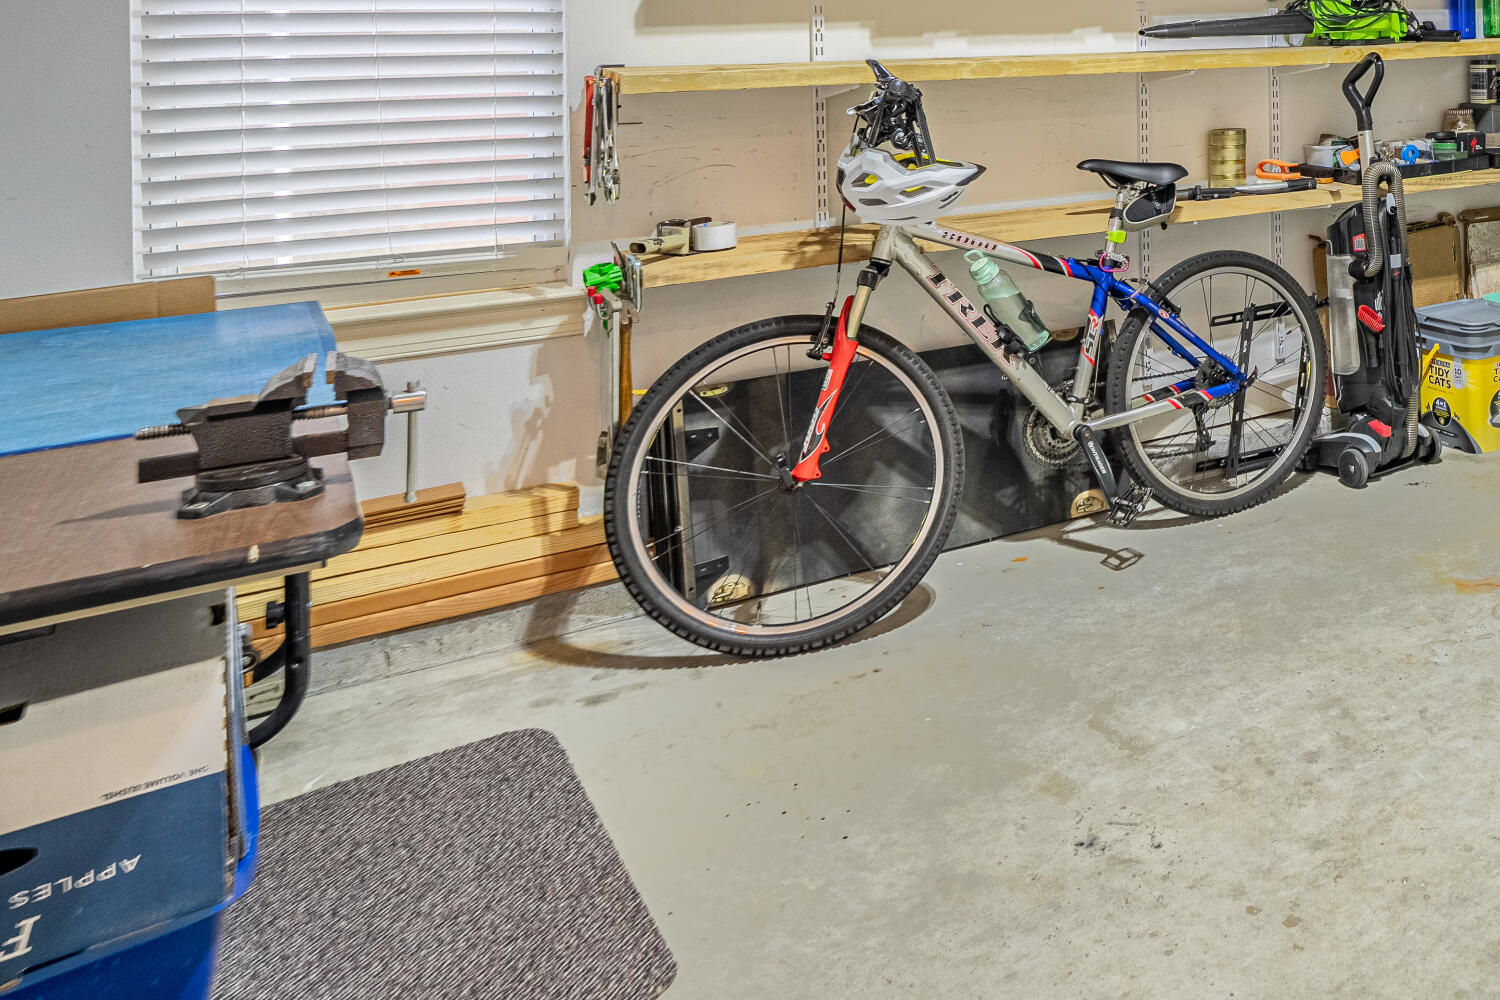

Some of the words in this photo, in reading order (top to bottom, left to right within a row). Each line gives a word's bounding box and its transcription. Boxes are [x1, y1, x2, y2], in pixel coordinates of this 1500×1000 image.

[928, 263, 1017, 367] TREK
[1429, 365, 1450, 378] TIDY
[1454, 367, 1462, 376] 10
[1428, 376, 1451, 389] CATS
[1087, 440, 1107, 475] BONTRAGER
[188, 764, 210, 777] ONE
[142, 771, 186, 790] VOLUME
[99, 783, 142, 801] BUSHEL
[9, 853, 142, 910] APPLES
